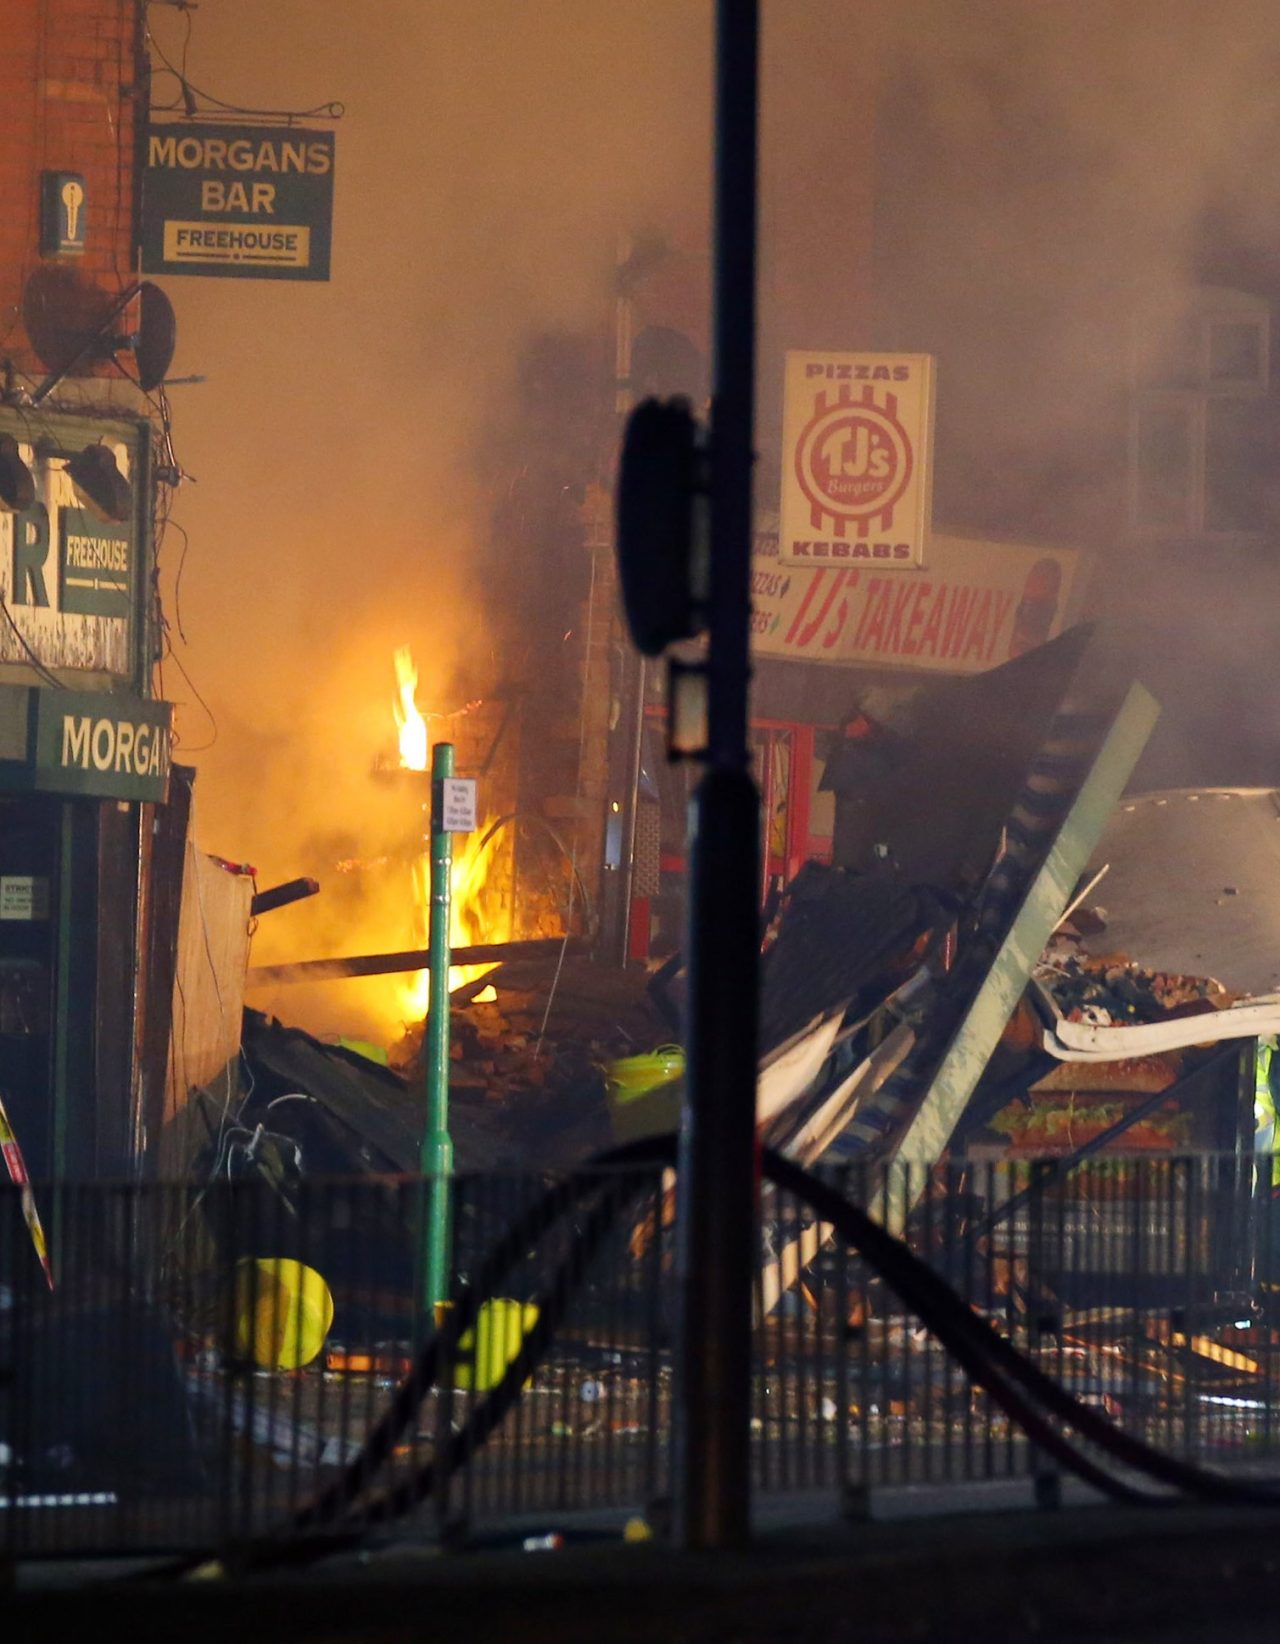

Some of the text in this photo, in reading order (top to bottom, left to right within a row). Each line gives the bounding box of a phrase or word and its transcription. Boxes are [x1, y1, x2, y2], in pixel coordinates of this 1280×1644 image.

[149, 137, 331, 174] MORGANS
[201, 180, 275, 214] BAR
[176, 228, 298, 251] FREEHOUSE
[804, 363, 910, 381] PIZZAS
[827, 479, 884, 497] Burgers
[66, 535, 129, 573] FREEHOUSE
[792, 541, 911, 559] KEBABS
[854, 577, 1017, 661] TAKEAWAY
